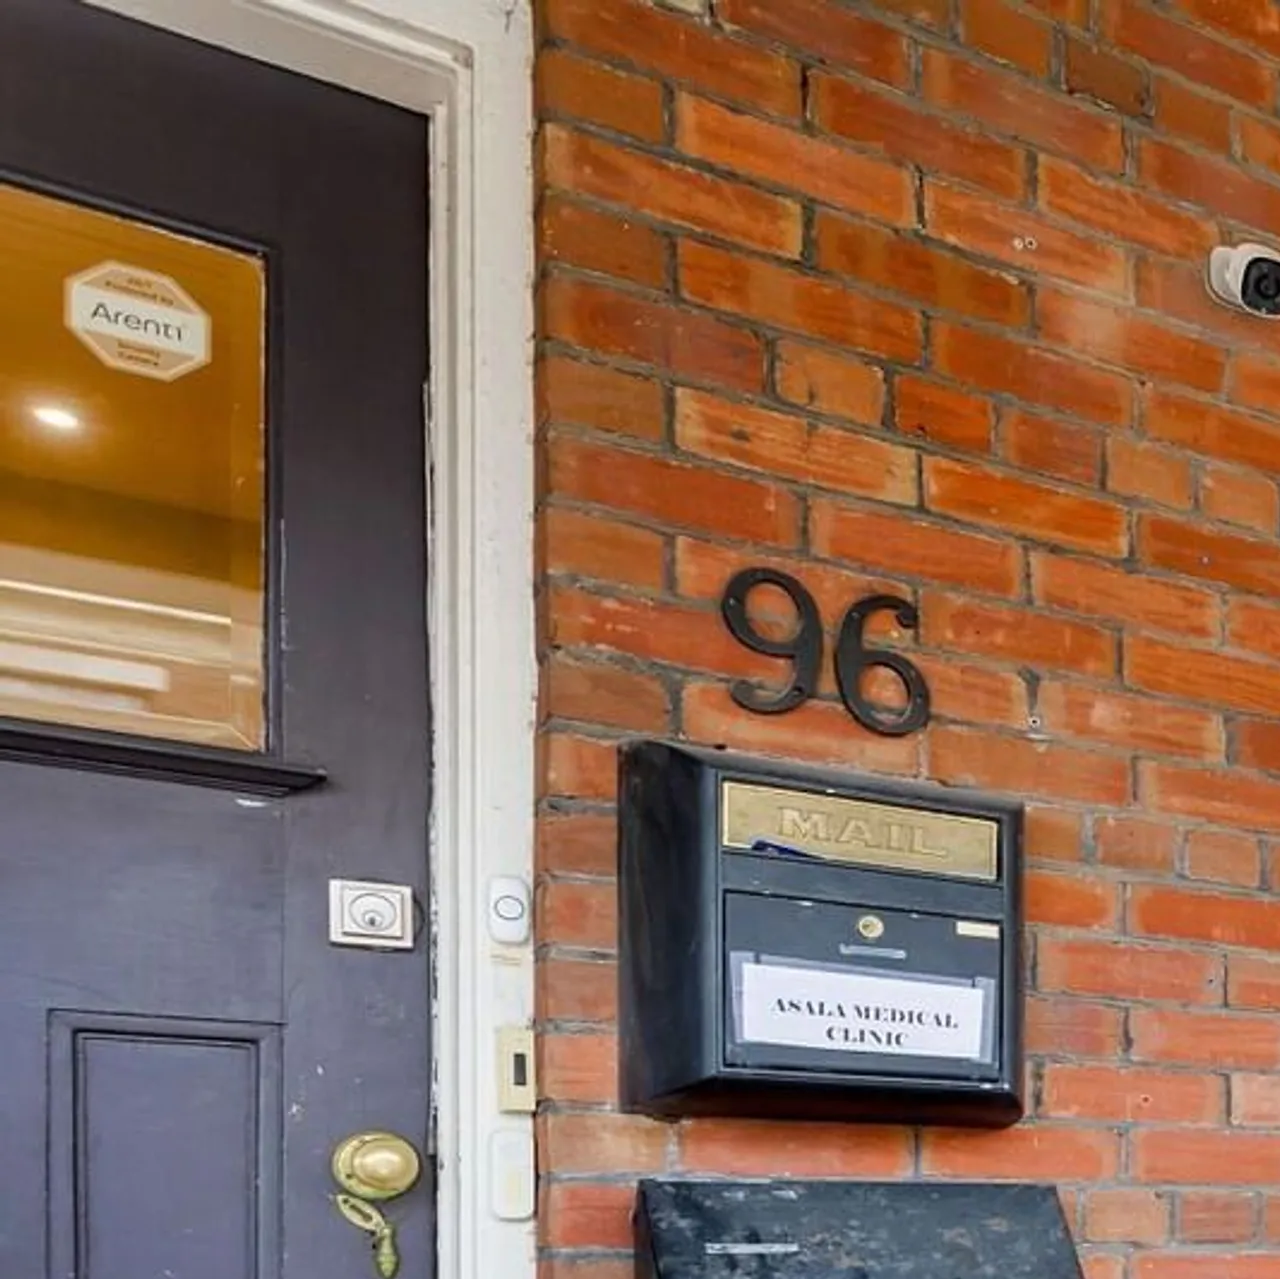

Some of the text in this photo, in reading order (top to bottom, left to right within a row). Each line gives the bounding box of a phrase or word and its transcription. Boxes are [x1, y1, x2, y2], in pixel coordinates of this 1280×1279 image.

[91, 302, 182, 341] Arenti
[721, 567, 930, 737] 96
[777, 806, 949, 858] MAIL
[772, 997, 958, 1028] ASALA MEDICAL
[826, 1026, 908, 1046] CLINIC
